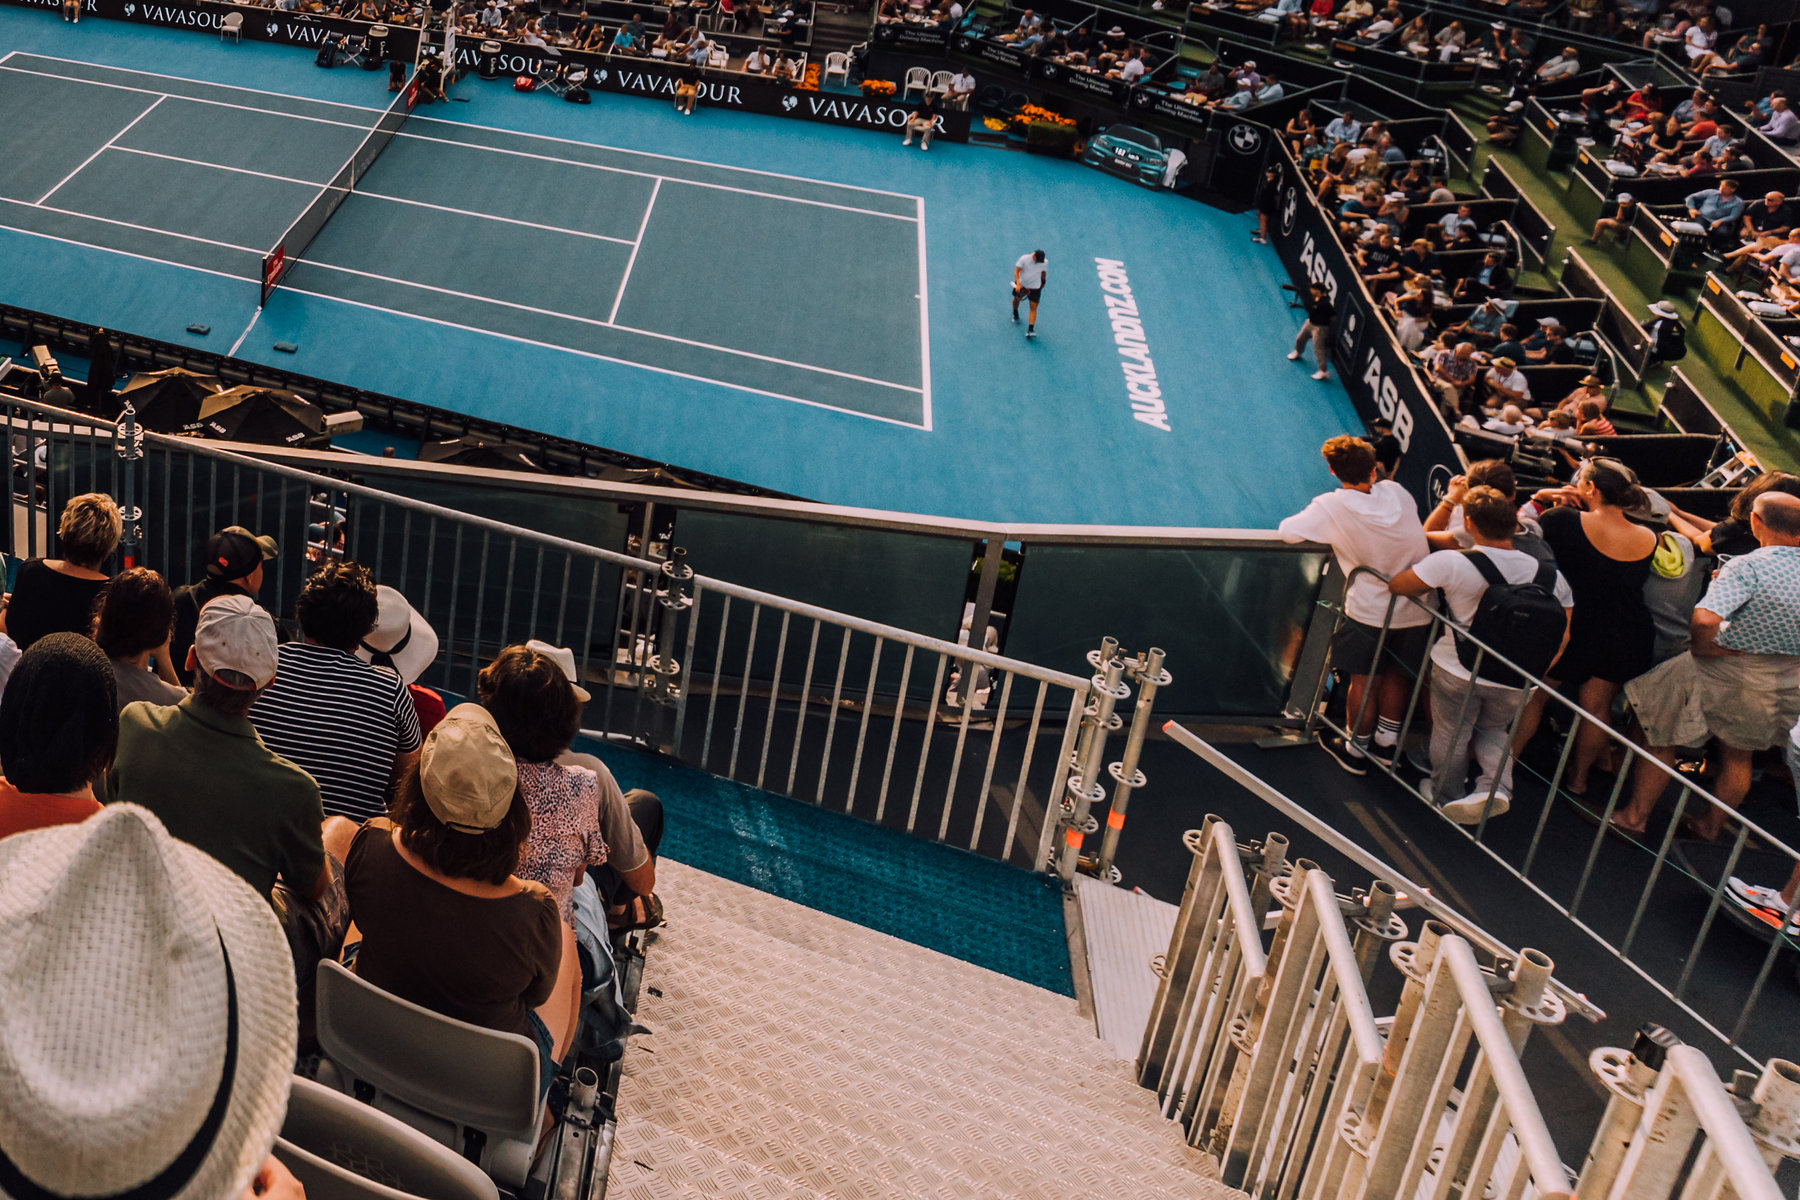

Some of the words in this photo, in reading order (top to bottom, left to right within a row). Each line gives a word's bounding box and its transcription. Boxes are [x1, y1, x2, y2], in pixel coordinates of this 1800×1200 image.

[142, 4, 224, 30] VAVASOU
[618, 70, 743, 105] VAVAOUR
[808, 96, 947, 135] VAVASOR
[1363, 348, 1414, 454] ASB
